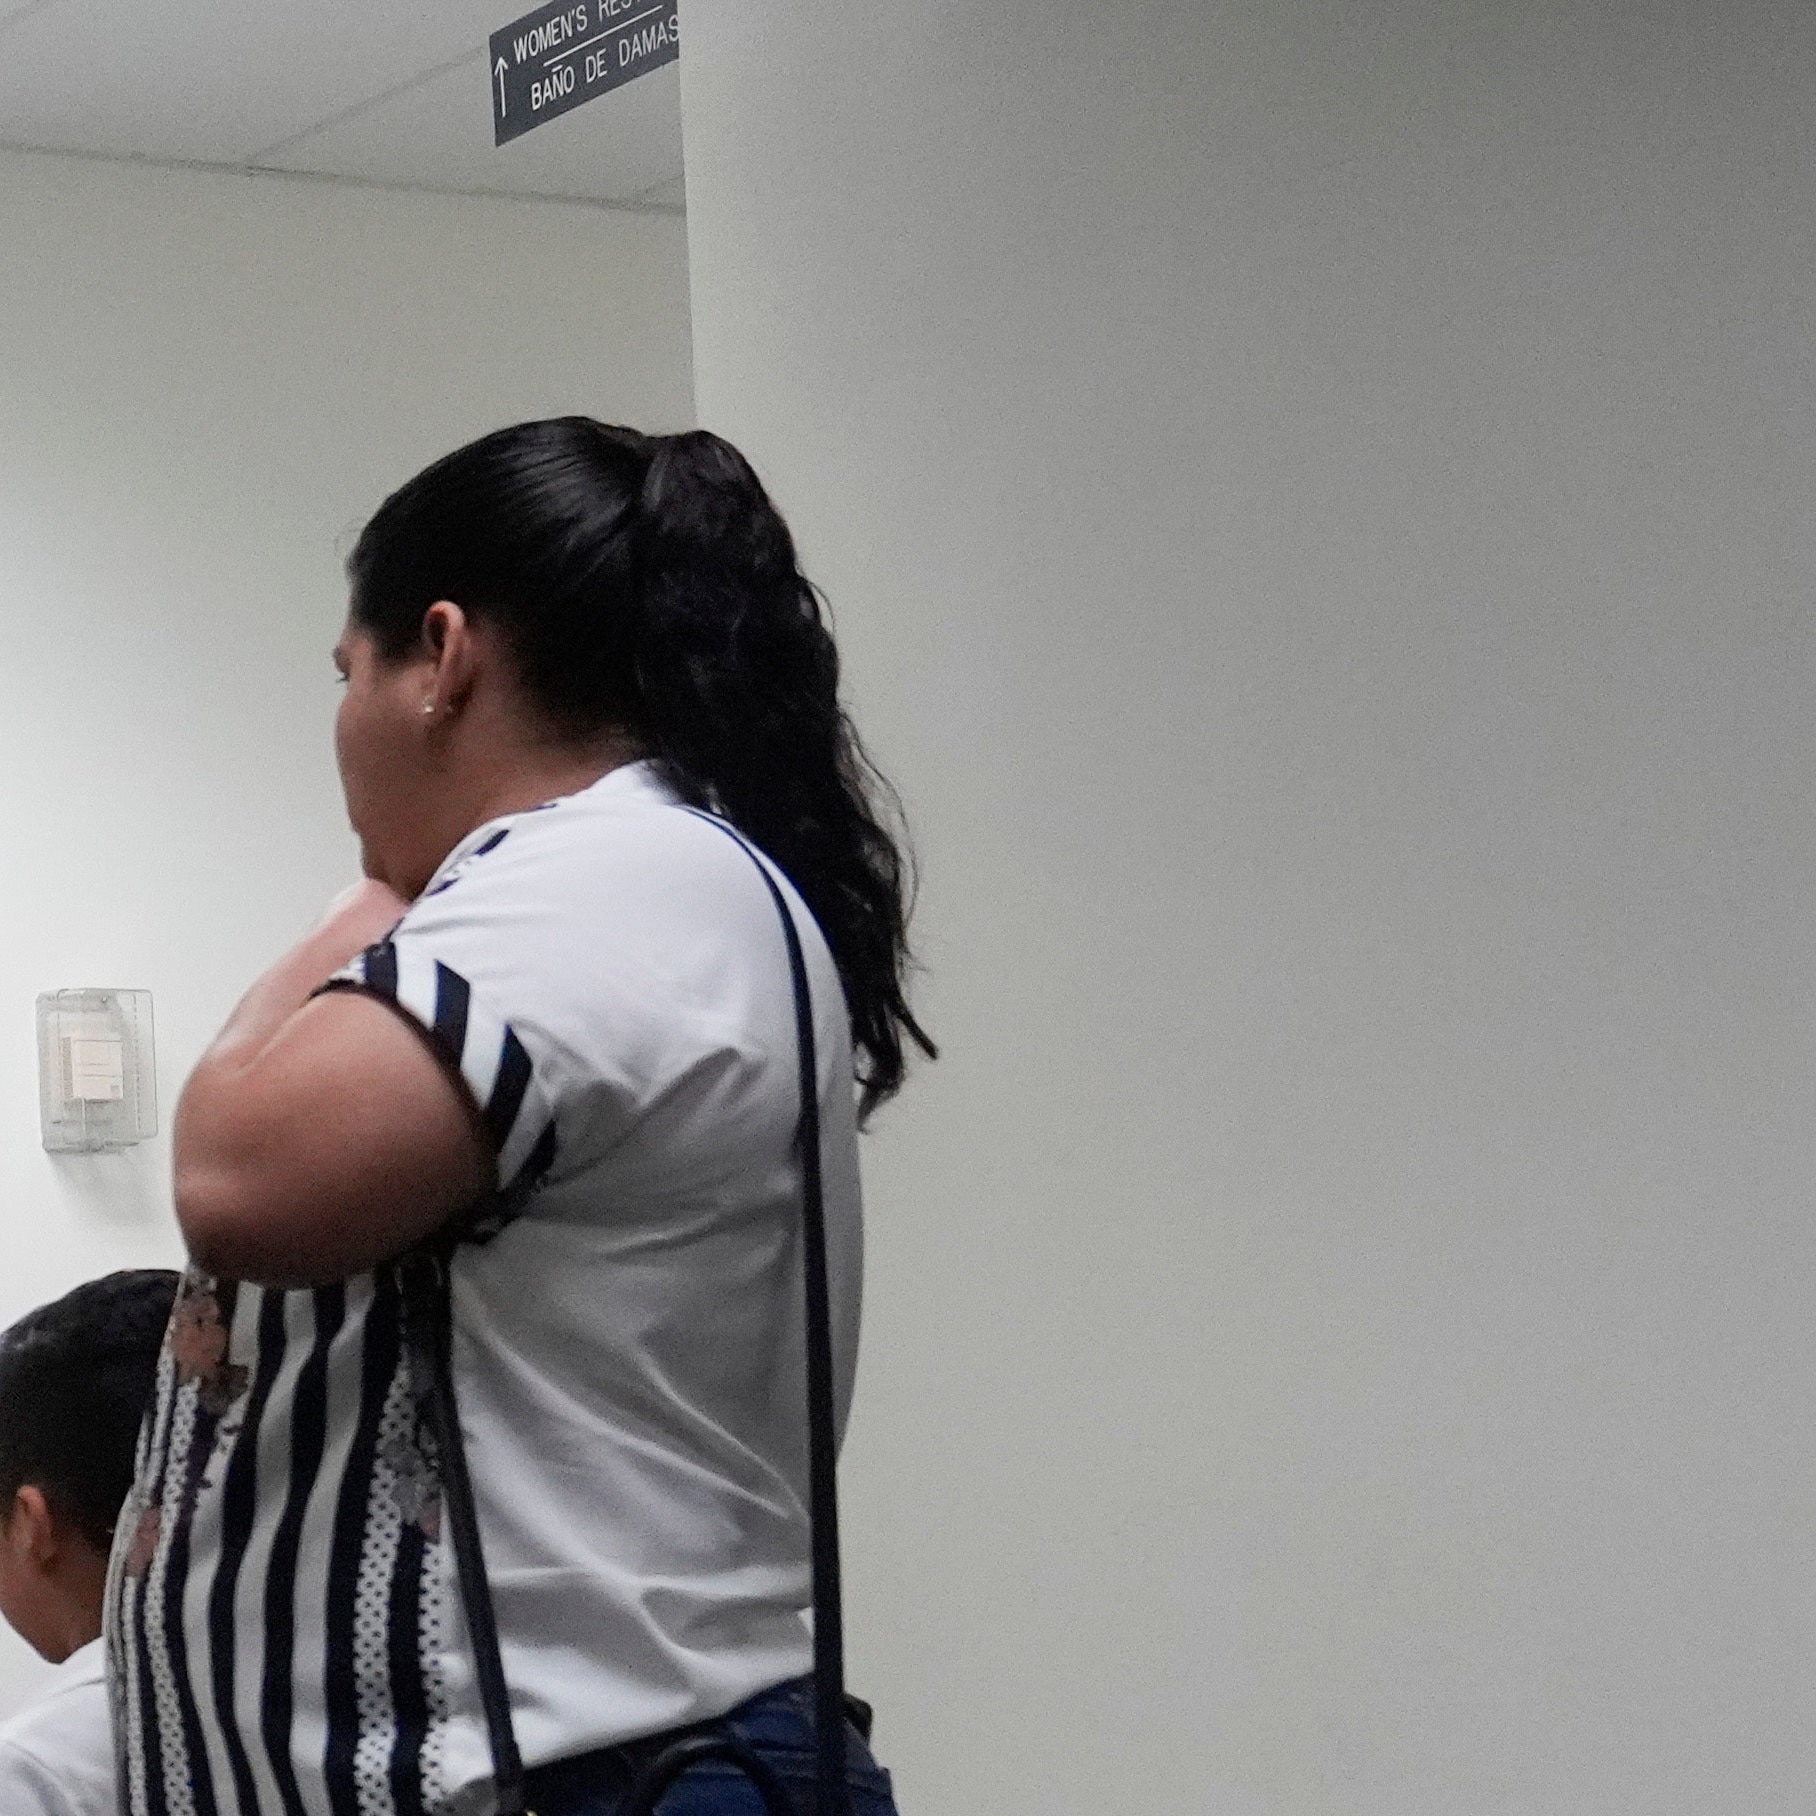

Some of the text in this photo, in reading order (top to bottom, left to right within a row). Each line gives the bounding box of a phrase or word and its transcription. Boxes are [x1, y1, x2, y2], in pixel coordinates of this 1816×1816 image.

[514, 4, 588, 65] WOMEN'S
[530, 15, 679, 111] BAÑO DE DAMAS
